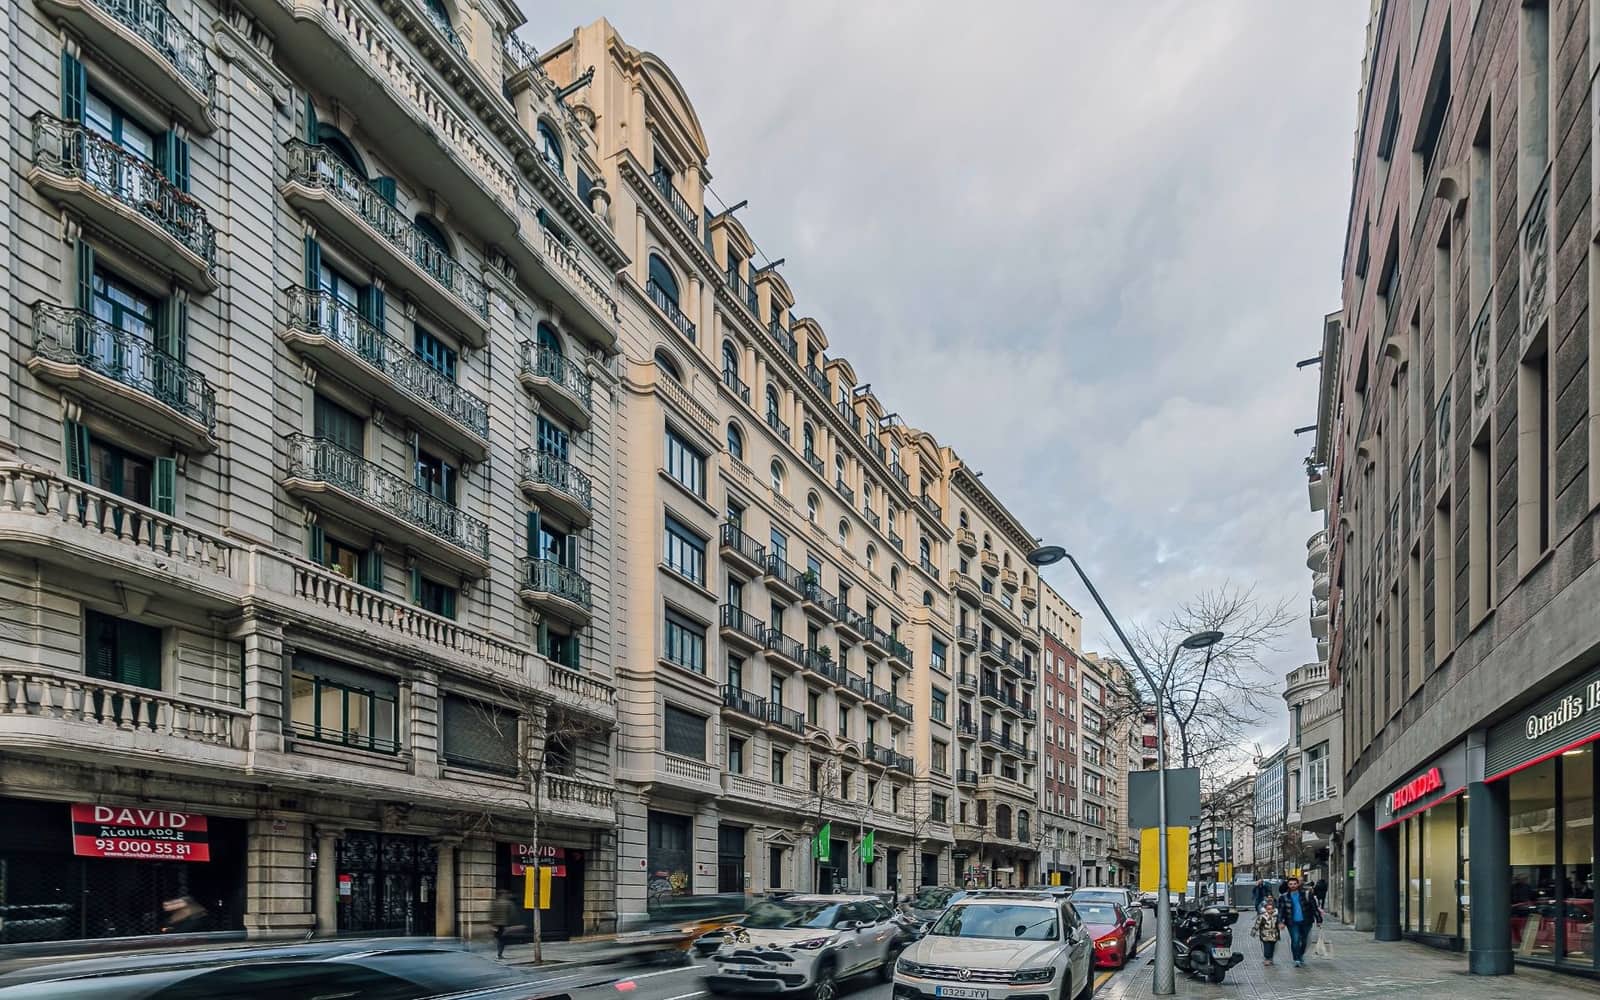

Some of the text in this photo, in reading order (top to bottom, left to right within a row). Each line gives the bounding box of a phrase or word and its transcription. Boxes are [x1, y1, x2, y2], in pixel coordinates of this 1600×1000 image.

[1526, 695, 1582, 739] Quadis
[1394, 767, 1441, 811] HONDA
[95, 806, 187, 828] DAVID
[100, 828, 173, 838] ALQUILADO
[96, 839, 191, 855] 93 000 55 81
